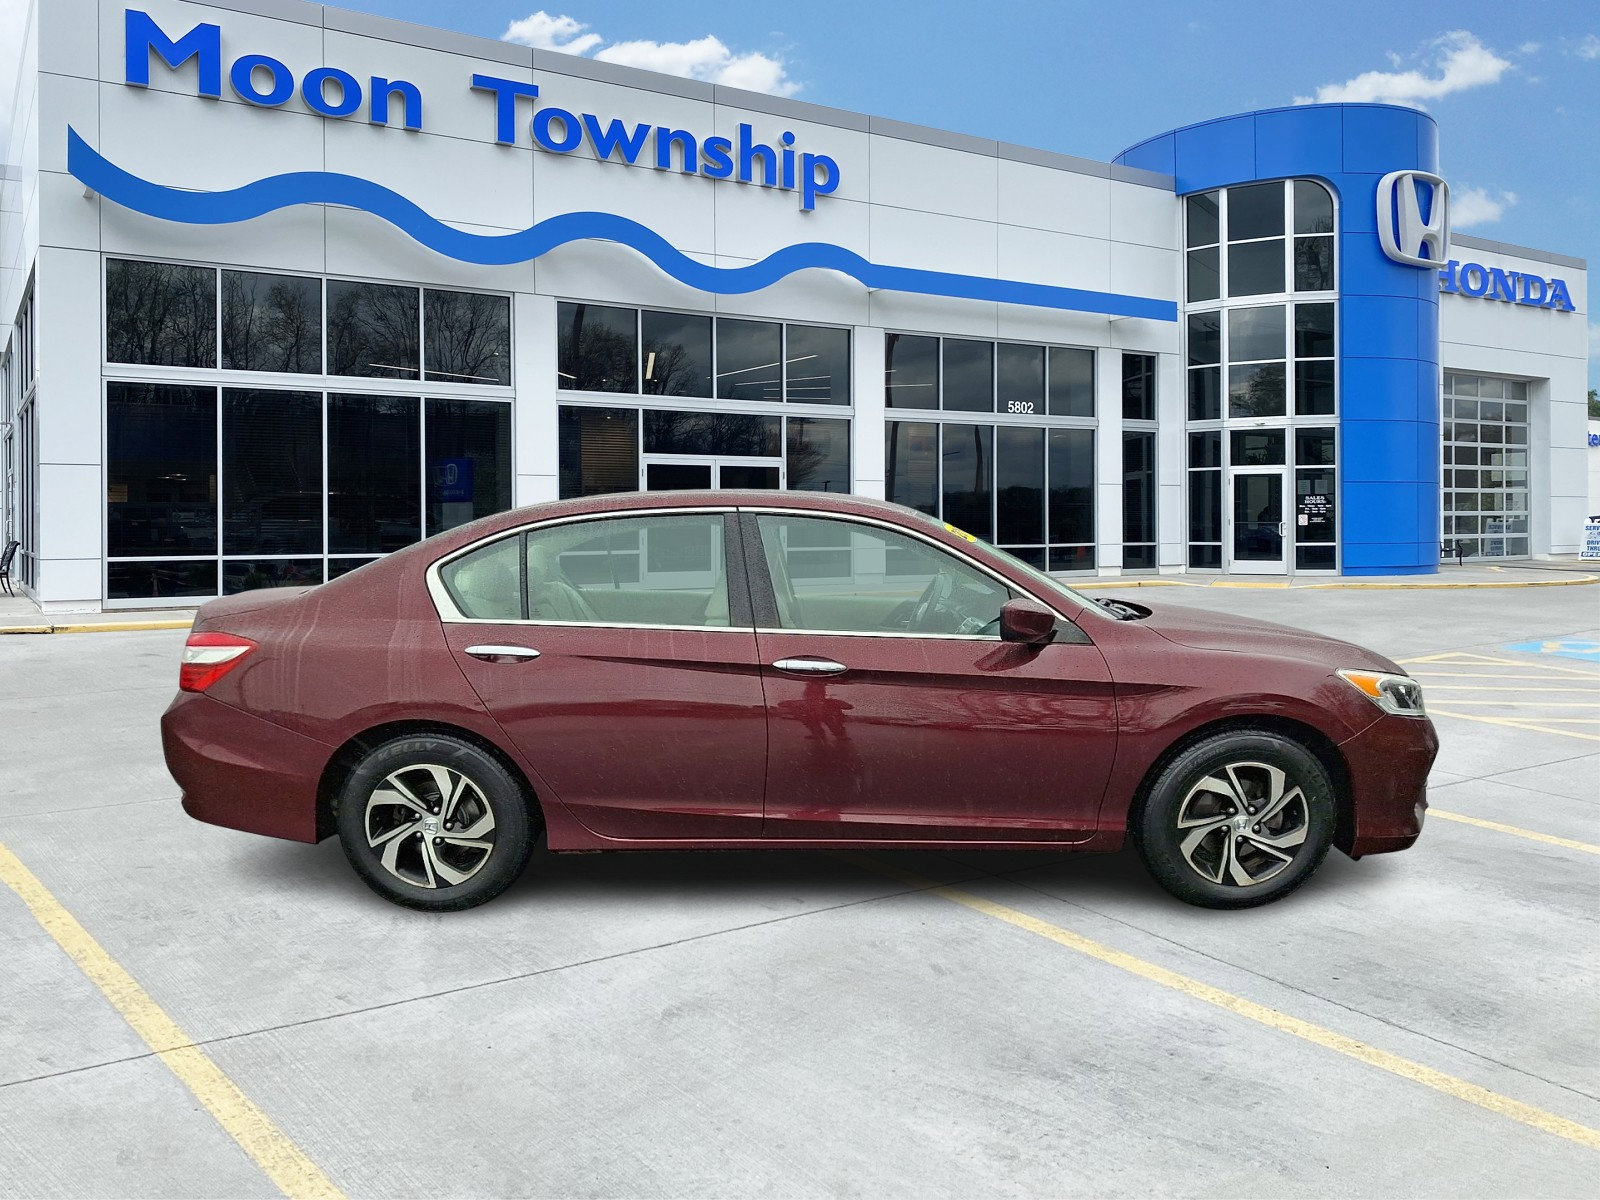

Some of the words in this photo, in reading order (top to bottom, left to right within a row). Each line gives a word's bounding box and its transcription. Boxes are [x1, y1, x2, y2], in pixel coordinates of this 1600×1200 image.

[125, 8, 422, 132] Moon
[469, 73, 841, 213] Township
[1007, 400, 1034, 414] 5802
